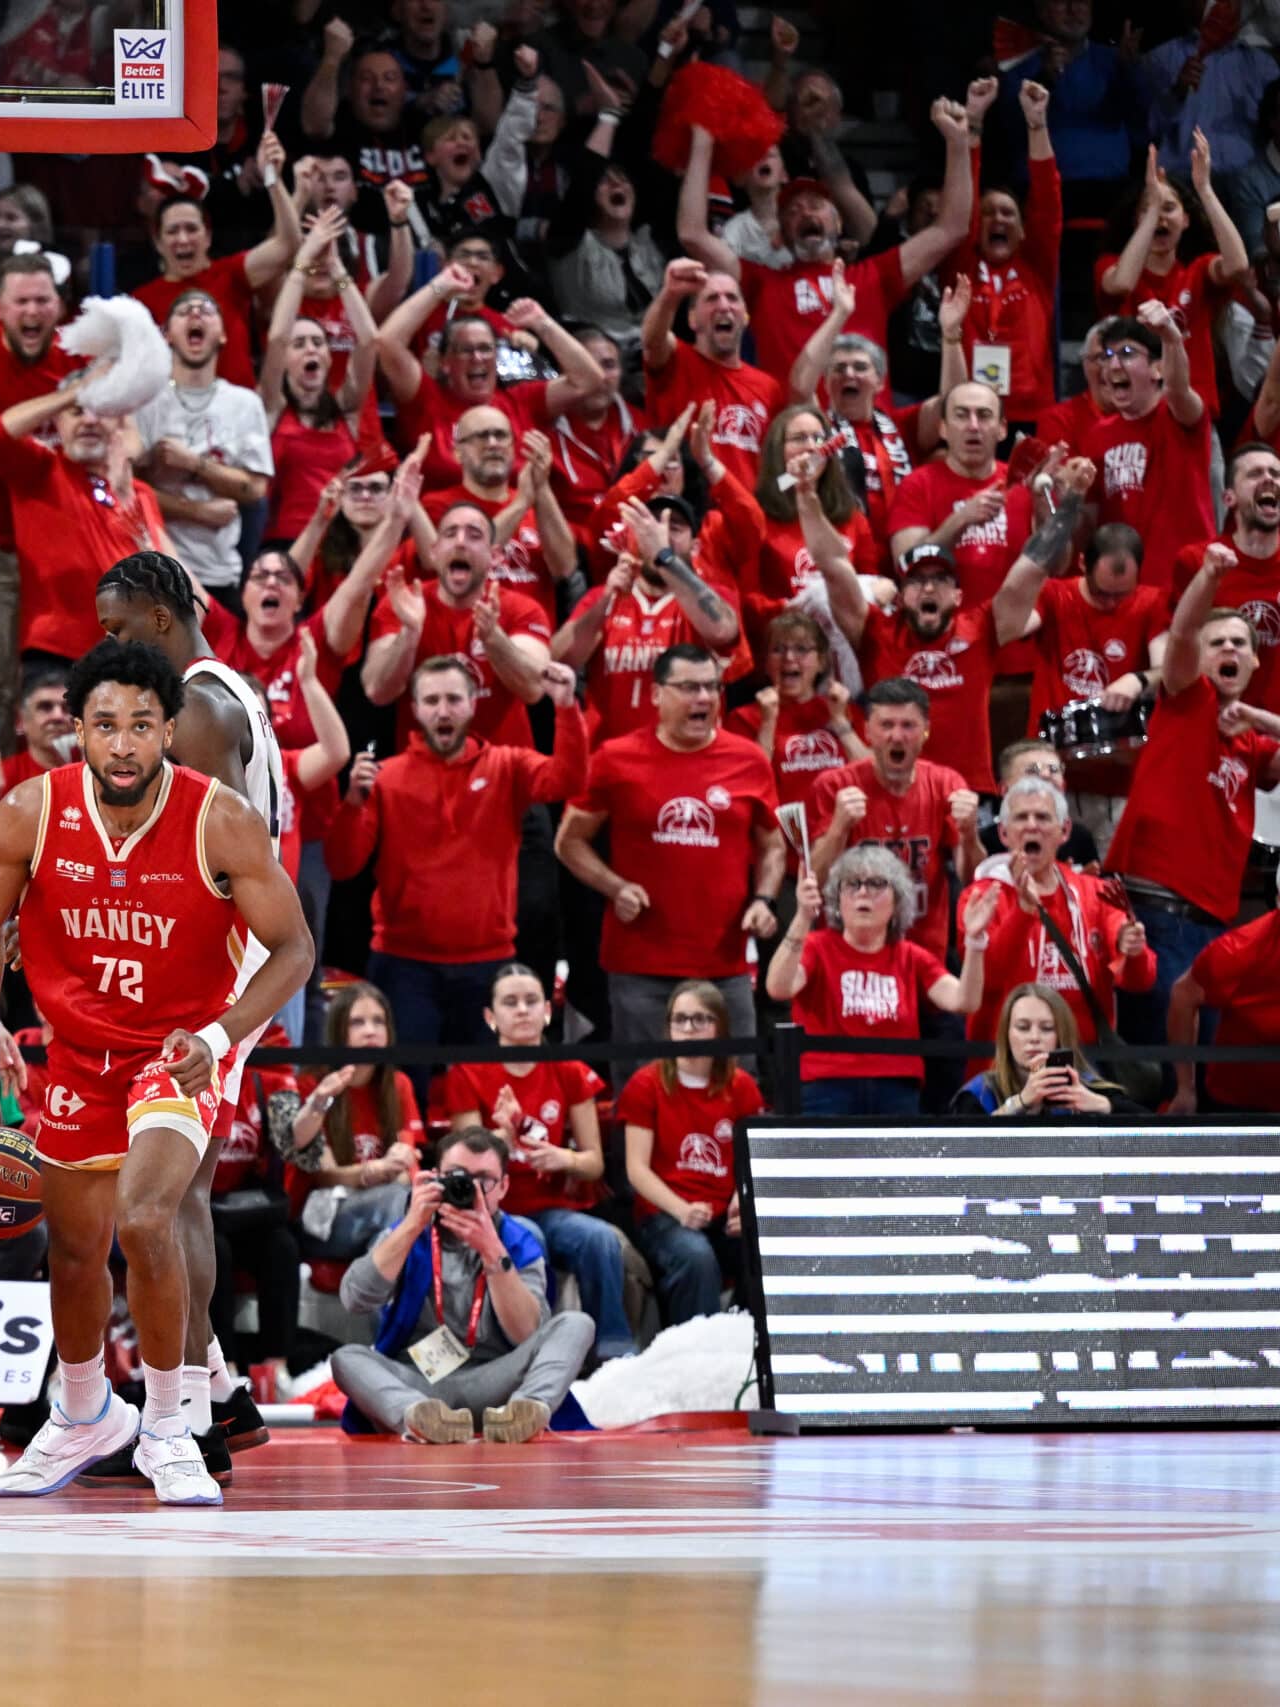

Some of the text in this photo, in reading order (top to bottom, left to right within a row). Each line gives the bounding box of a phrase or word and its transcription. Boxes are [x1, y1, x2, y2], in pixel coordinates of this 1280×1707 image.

[124, 66, 161, 77] Betclic
[121, 80, 165, 99] ÉLITE
[56, 858, 96, 875] FCGE
[91, 897, 144, 909] GRAND
[60, 908, 177, 949] NANCY
[92, 954, 144, 1004] 72
